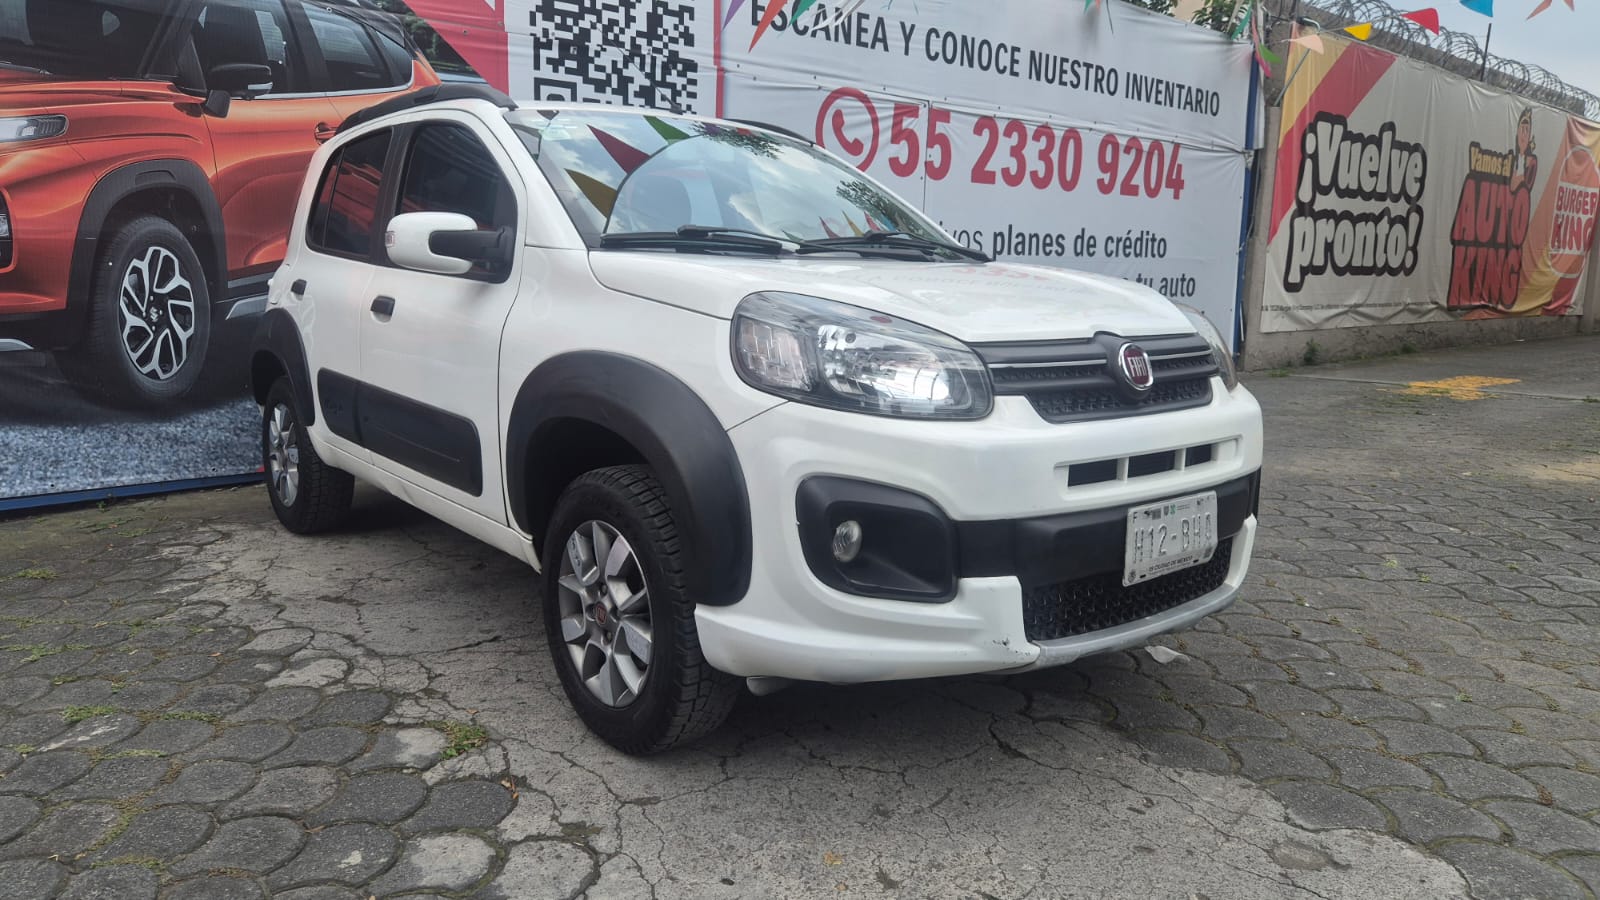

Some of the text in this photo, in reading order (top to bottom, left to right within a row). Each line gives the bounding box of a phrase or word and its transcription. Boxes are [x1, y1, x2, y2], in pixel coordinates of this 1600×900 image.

[751, 0, 1220, 117] ESCANEA Y CONOCE NUESTRO INVENTARIO
[888, 103, 1184, 200] 55 2330 9204
[1298, 116, 1425, 204] ¡Vuelve
[1471, 146, 1513, 176] Vamos al
[992, 224, 1066, 261] planes
[1073, 227, 1097, 258] de
[1104, 229, 1167, 259] crédito
[1452, 178, 1530, 246] AUTO
[1287, 211, 1420, 285] pronto!
[1450, 245, 1522, 307] KING
[1159, 273, 1196, 298] auto
[1126, 356, 1148, 377] FIAT
